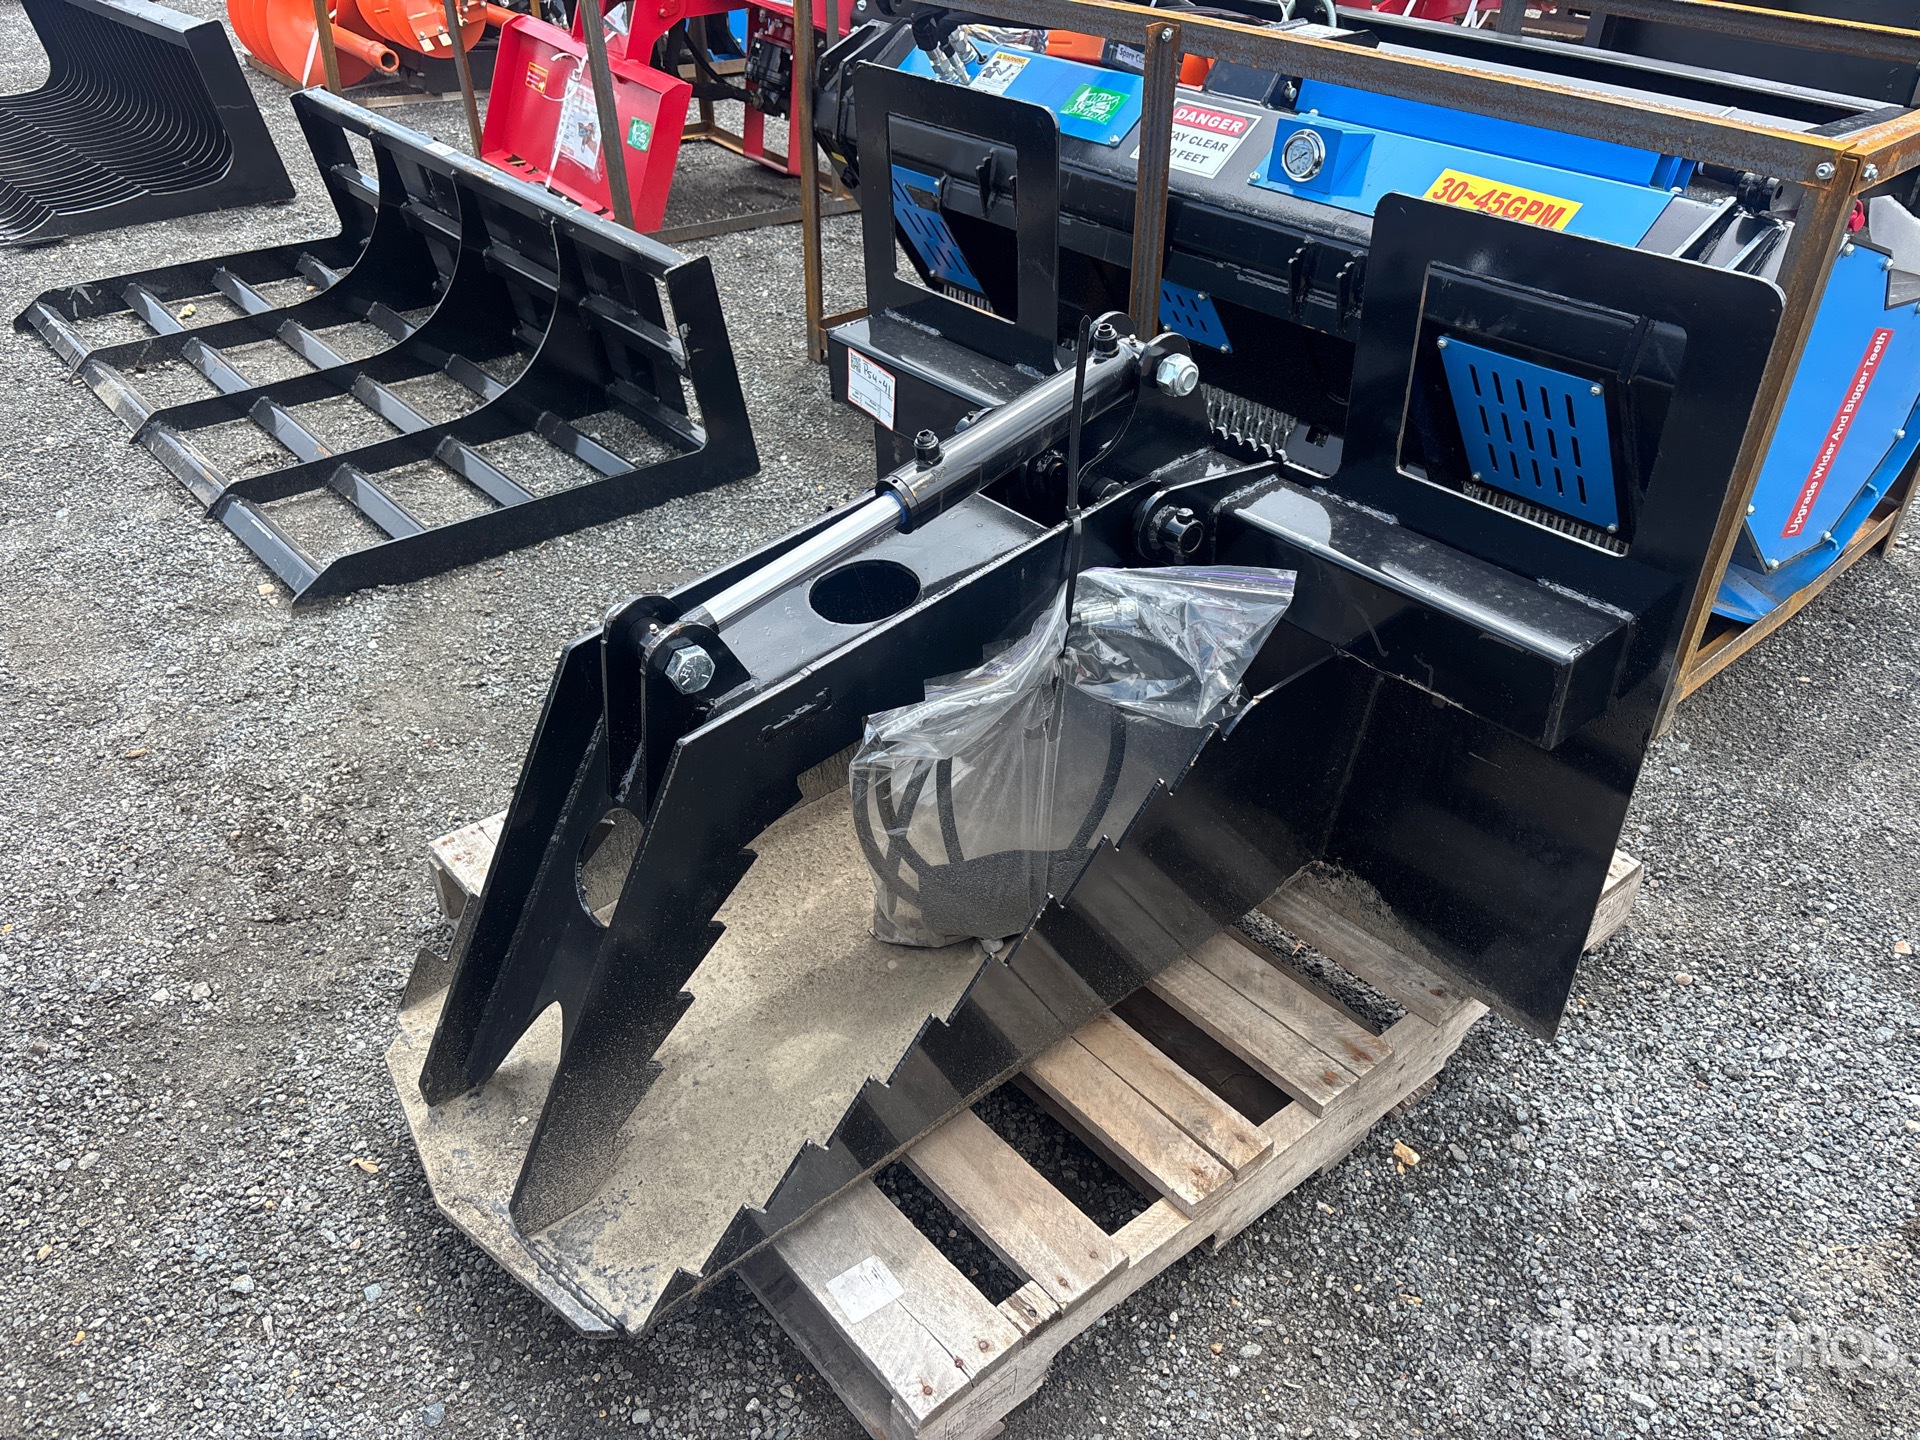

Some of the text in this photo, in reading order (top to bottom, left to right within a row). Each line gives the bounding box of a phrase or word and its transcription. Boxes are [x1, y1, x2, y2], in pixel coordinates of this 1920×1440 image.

[1119, 47, 1135, 60] Spare
[1174, 108, 1244, 134] DANGER
[1189, 136, 1229, 152] CLEAR
[1176, 149, 1209, 164] FEET
[1432, 178, 1567, 227] 30~45GPM
[1787, 332, 1888, 534] Upgrade Wider And Bigger Teeth
